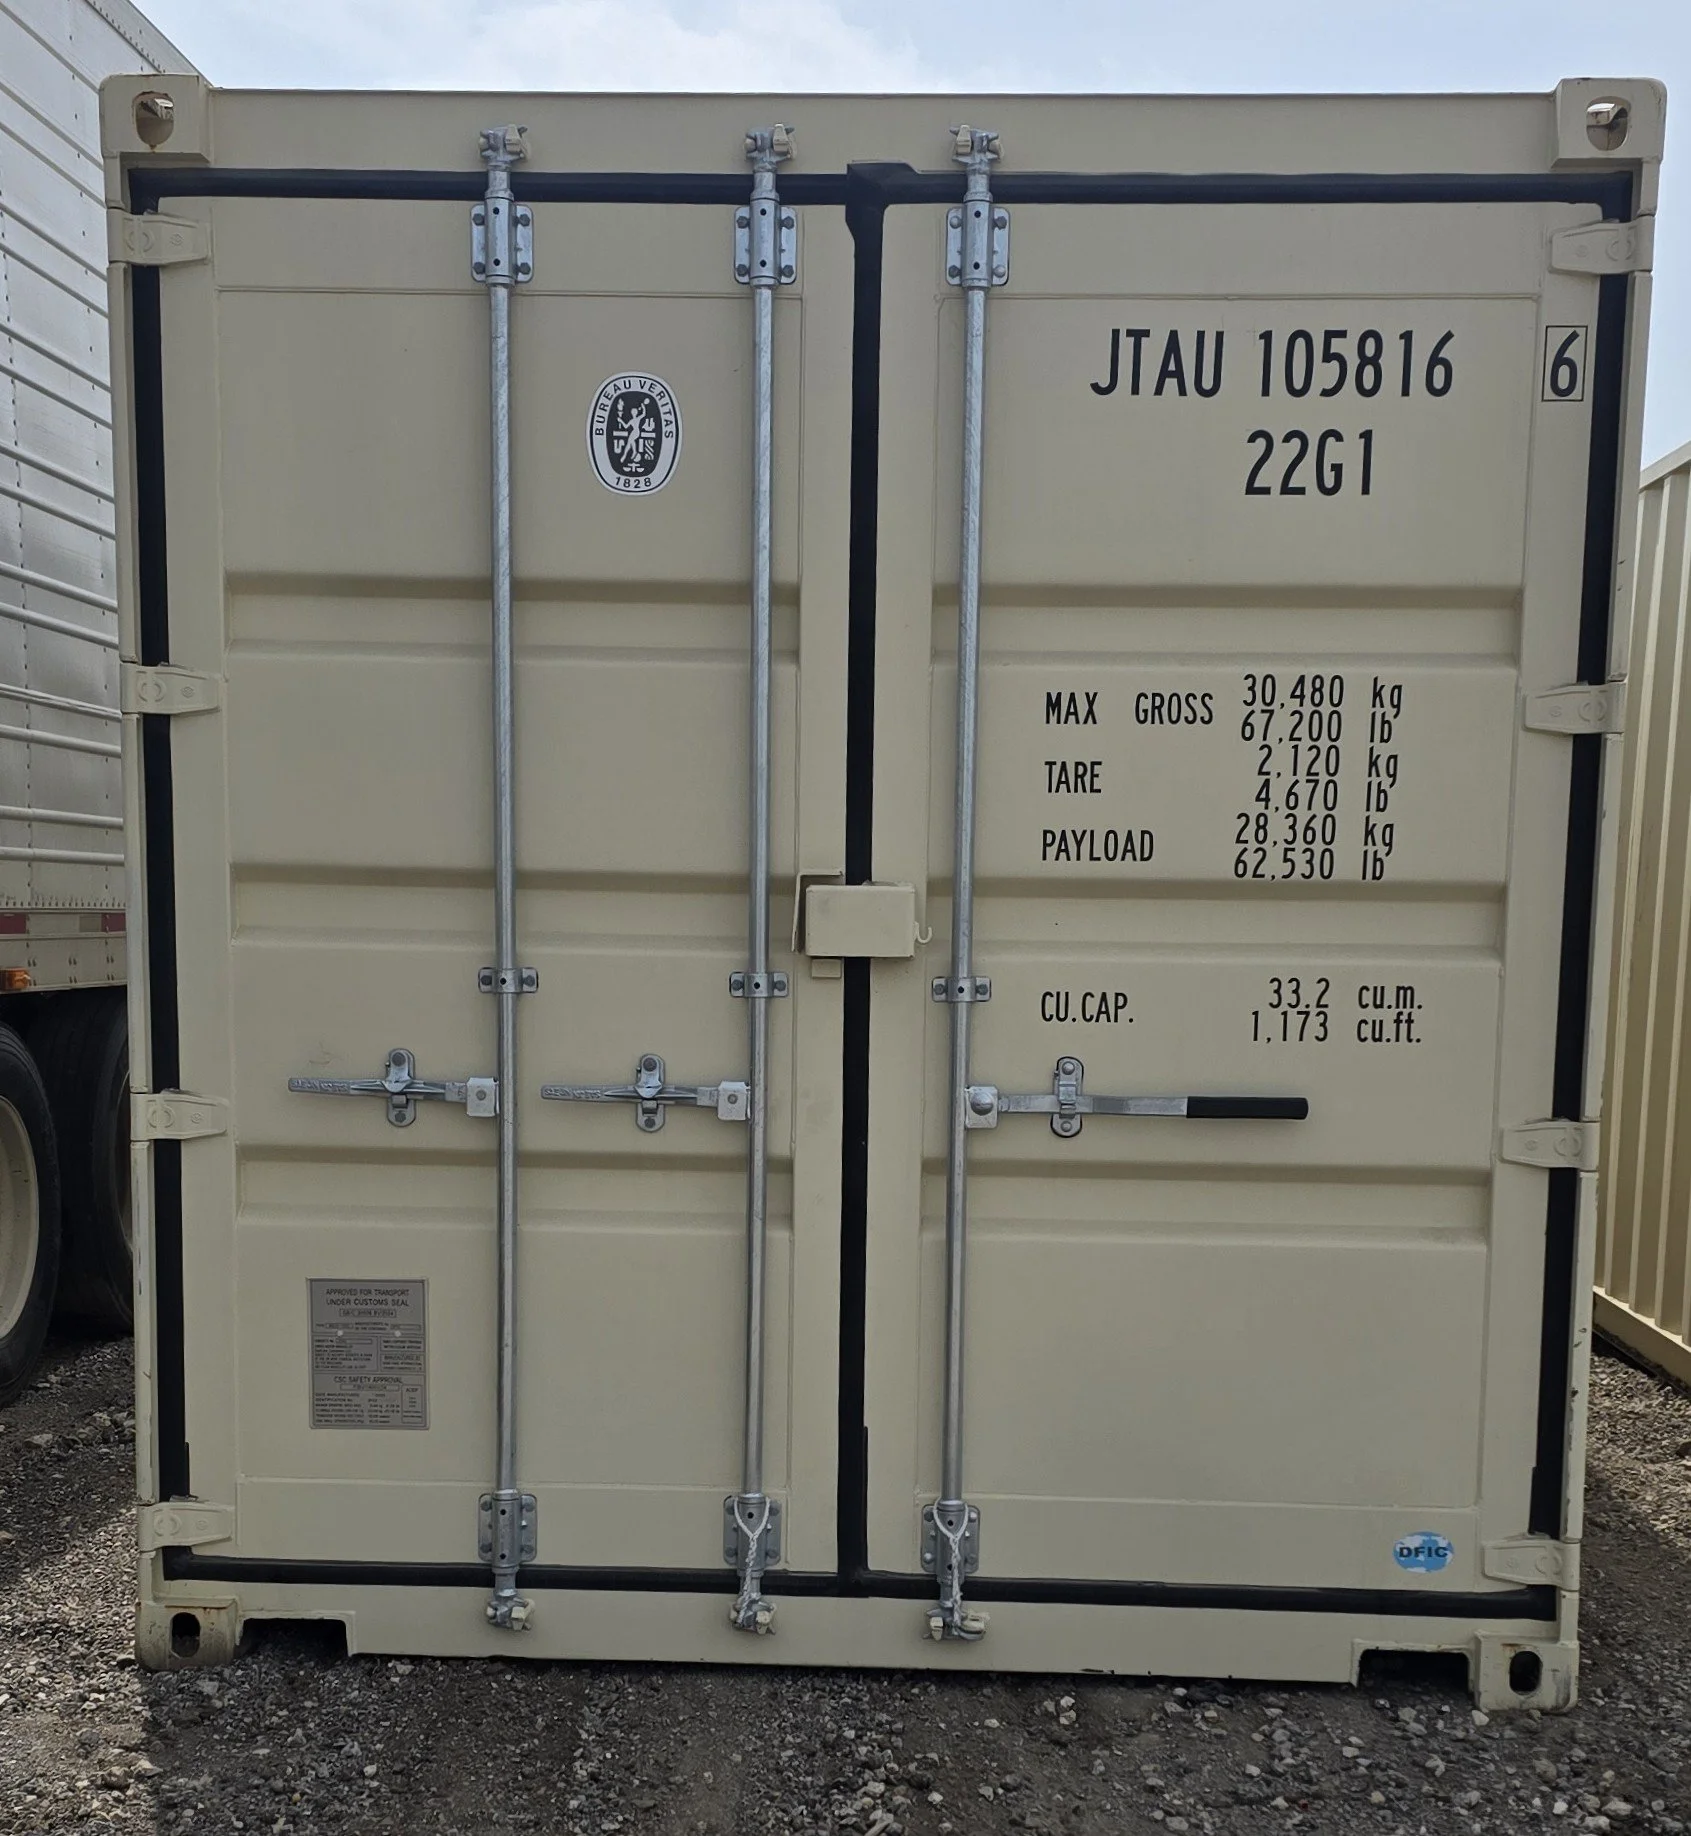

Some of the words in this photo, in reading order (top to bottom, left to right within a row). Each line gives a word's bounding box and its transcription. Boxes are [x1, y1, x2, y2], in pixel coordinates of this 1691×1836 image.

[1090, 328, 1224, 397] JTAU
[1258, 328, 1455, 398] 105816
[1549, 330, 1580, 398] 6
[595, 380, 631, 436] BUREAU
[639, 380, 673, 438] VERITAS
[615, 477, 652, 488] 1828
[1245, 429, 1373, 496] 22G1
[1045, 691, 1098, 725] MAX
[1135, 692, 1214, 725] GROSS
[1243, 673, 1344, 709] 30,480
[1372, 676, 1403, 718] kg
[1241, 709, 1342, 744] 67,200
[1370, 711, 1393, 743] lb
[1045, 761, 1102, 793] TARE
[1257, 744, 1340, 779] 2,120
[1368, 747, 1398, 788] kg
[1255, 779, 1337, 812] 4,670
[1366, 780, 1388, 812] lb
[1042, 829, 1154, 862] PAYLOAD
[1235, 813, 1336, 847] 28,360
[1364, 816, 1395, 857] kg
[1234, 847, 1334, 882] 62,530
[1362, 850, 1384, 881] lb
[1041, 991, 1134, 1023] CU.CAP.
[1269, 977, 1330, 1009] 33.2
[1358, 984, 1423, 1009] cu.m.
[1252, 1010, 1329, 1044] 1,173
[1357, 1011, 1421, 1043] cu.ft.
[1399, 1547, 1448, 1557] DFIC
